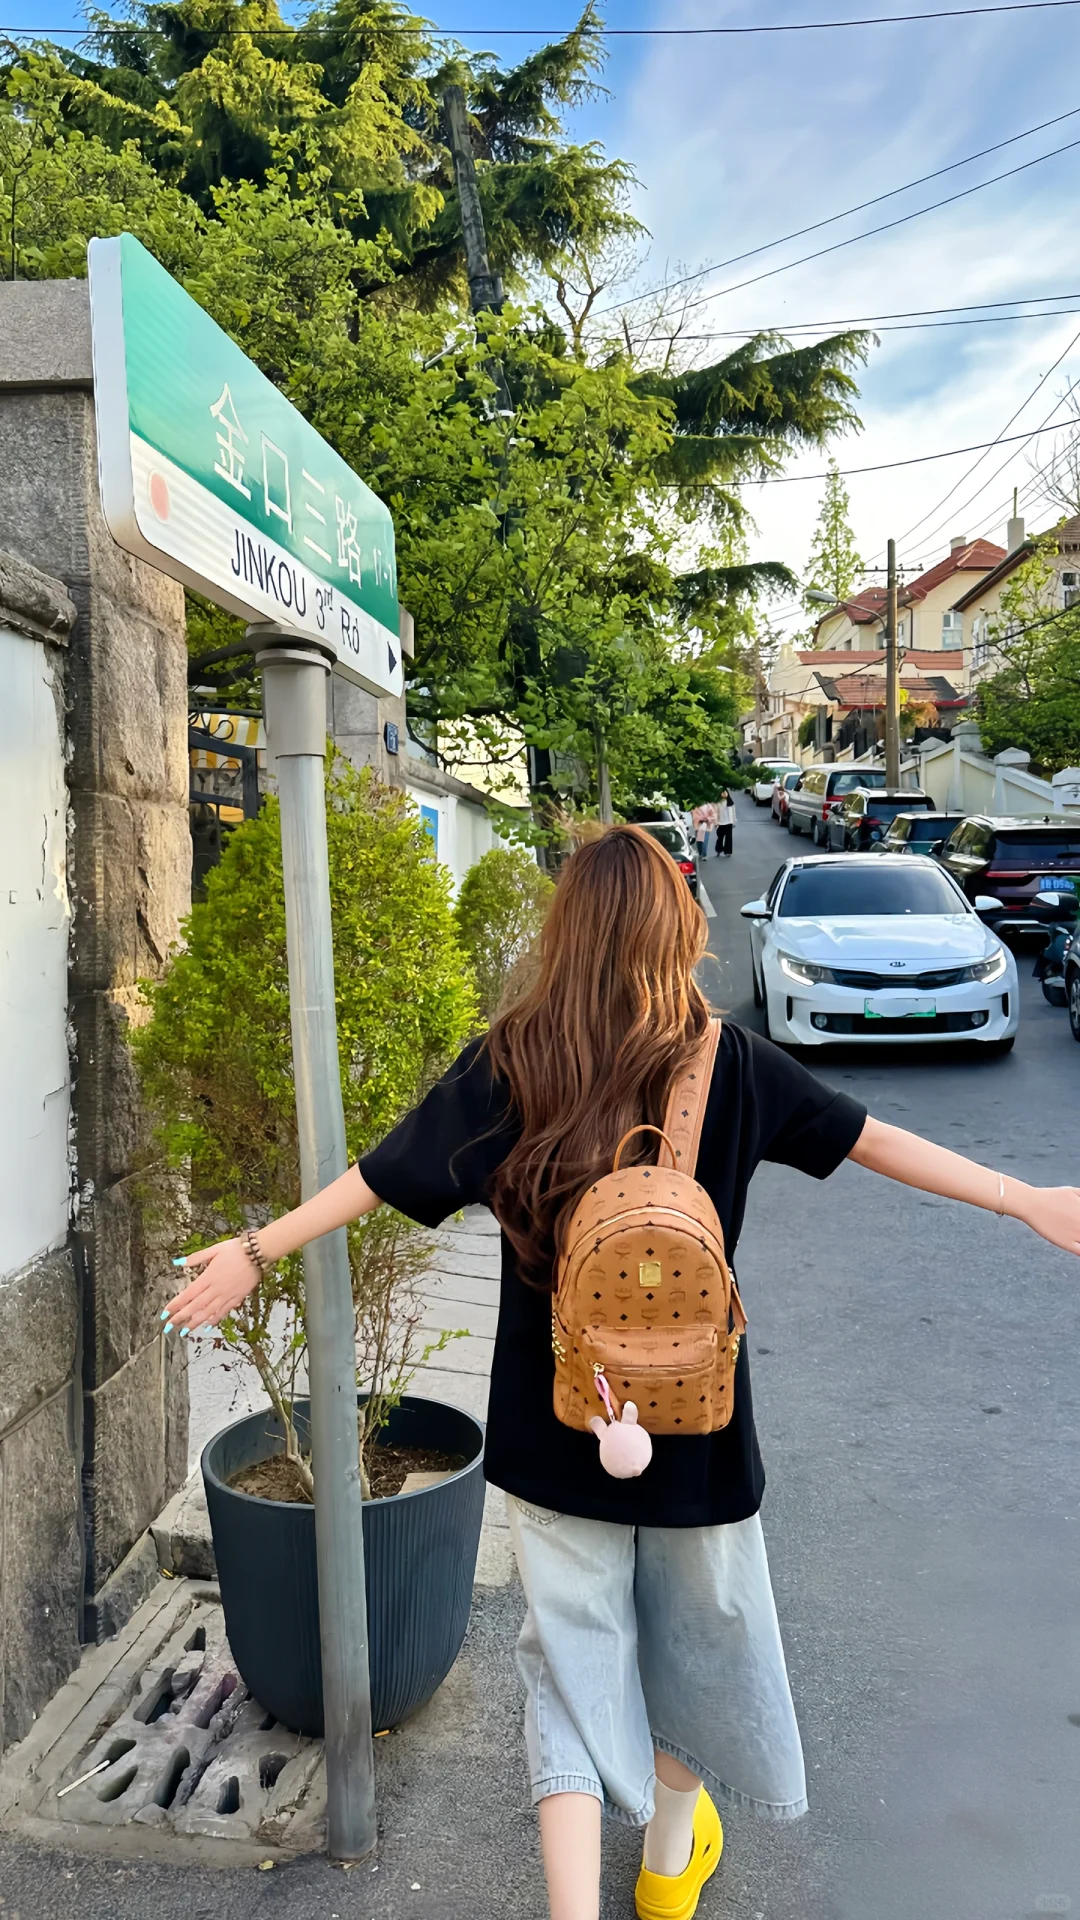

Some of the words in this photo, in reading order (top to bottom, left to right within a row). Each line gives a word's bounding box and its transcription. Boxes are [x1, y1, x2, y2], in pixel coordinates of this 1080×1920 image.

[210, 382, 362, 590] 金口三路
[231, 528, 306, 617] JINKOU
[315, 587, 333, 631] 3rd
[340, 606, 360, 655] Rd
